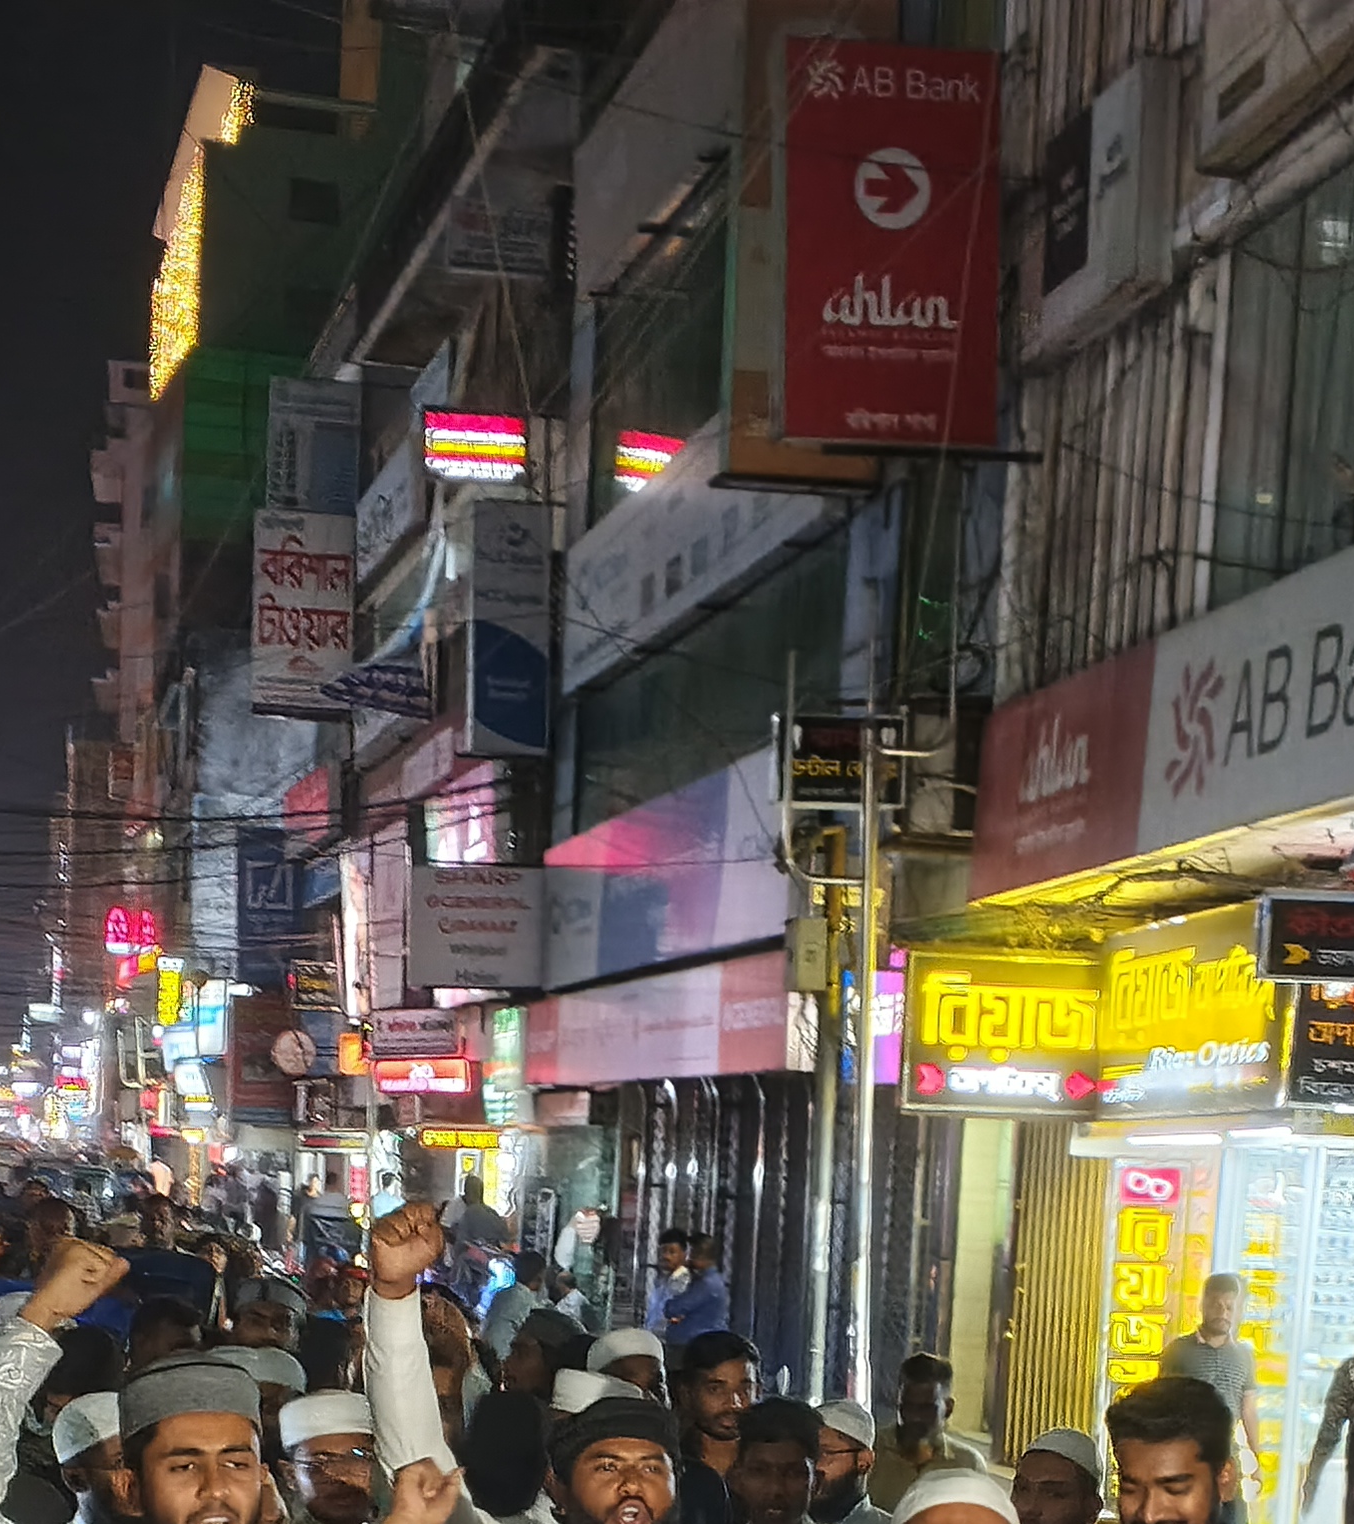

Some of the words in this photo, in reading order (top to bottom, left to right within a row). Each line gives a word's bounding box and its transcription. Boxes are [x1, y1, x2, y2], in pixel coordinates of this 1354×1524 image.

[853, 65, 895, 98] AB
[905, 69, 981, 102] Bank
[822, 272, 961, 328] ahlan
[1223, 643, 1293, 768] AB
[922, 970, 1101, 1063] রিয়াজ
[1110, 943, 1197, 1045] রিয়াজ
[1196, 1037, 1272, 1067] Optics
